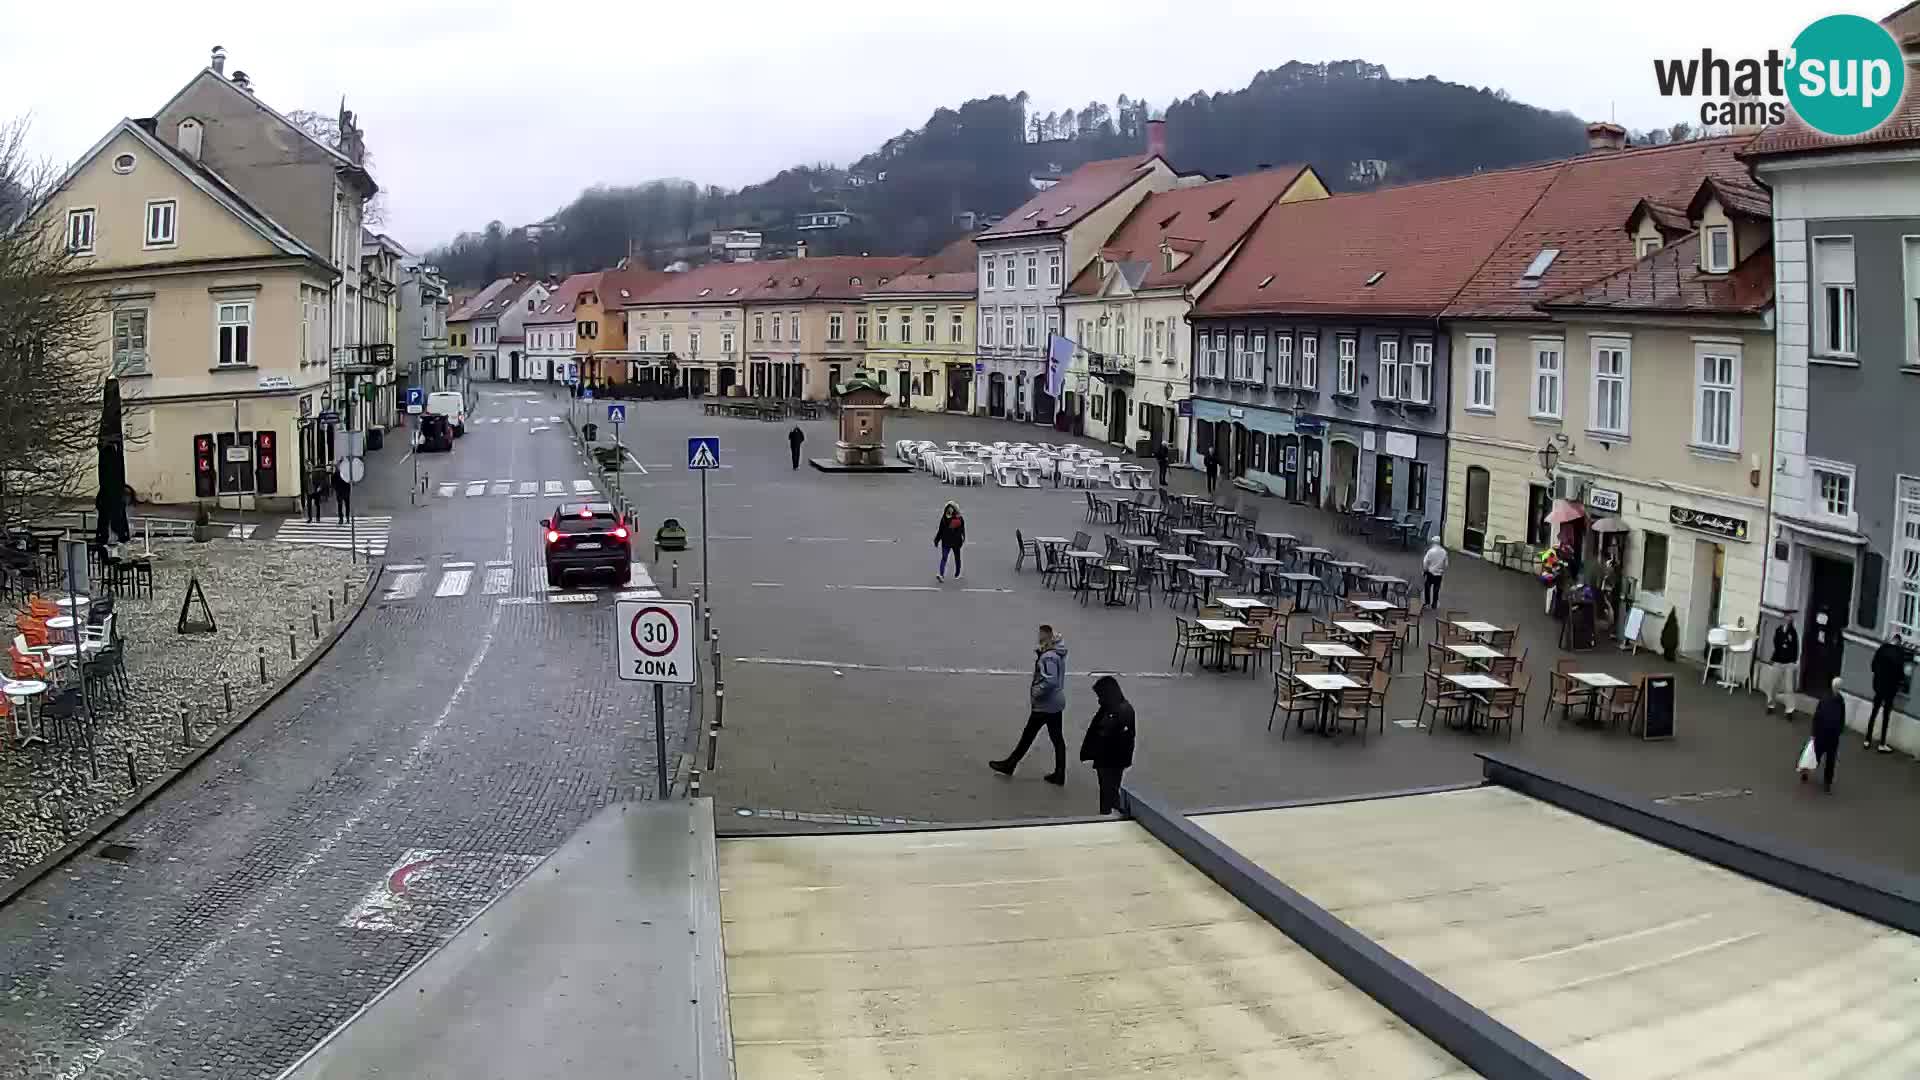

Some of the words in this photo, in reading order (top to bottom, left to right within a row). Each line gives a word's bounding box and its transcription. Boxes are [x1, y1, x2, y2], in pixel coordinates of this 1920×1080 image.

[411, 391, 419, 402] P
[643, 623, 667, 643] 30
[634, 659, 678, 677] ZONA
